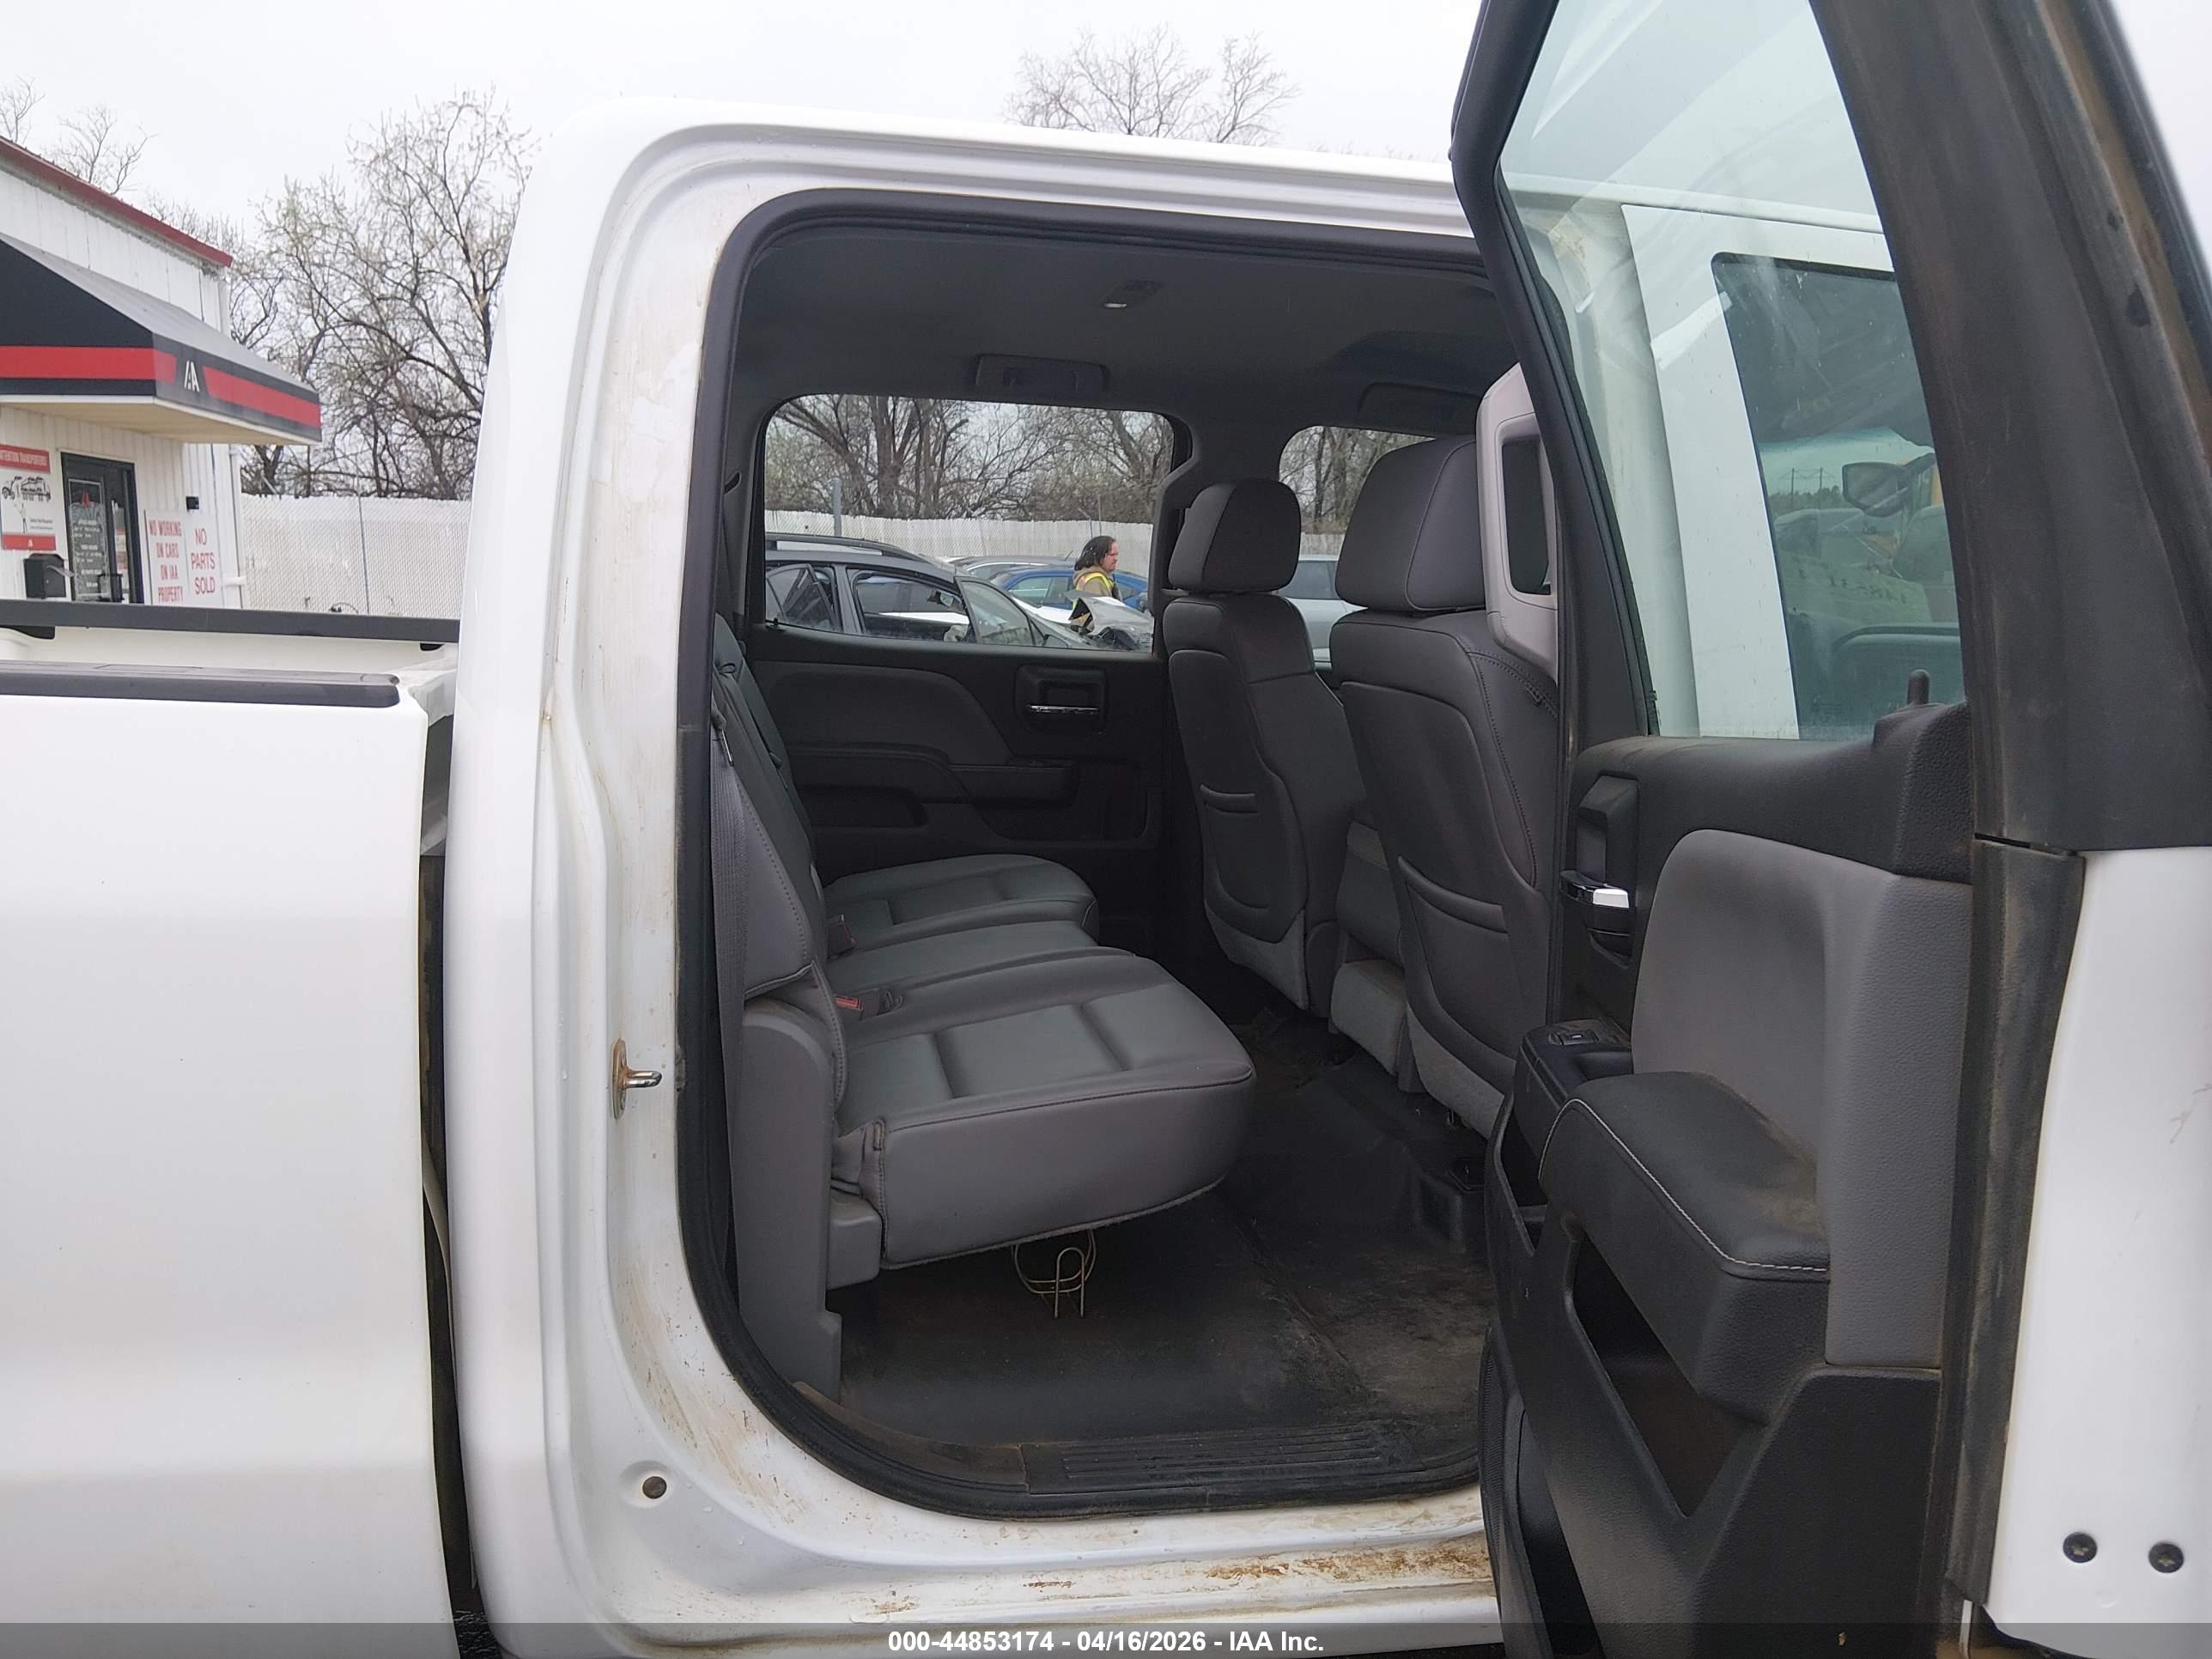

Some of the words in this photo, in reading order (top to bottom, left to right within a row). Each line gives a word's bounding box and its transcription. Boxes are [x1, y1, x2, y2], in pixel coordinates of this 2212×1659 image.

[149, 520, 157, 537] NO
[158, 521, 181, 537] WORKING
[195, 528, 207, 545] NO
[156, 543, 164, 558] ON
[166, 543, 179, 558] CARS
[191, 552, 216, 570] PARTS
[160, 564, 168, 580] ON
[194, 576, 216, 595] SOLD
[158, 586, 183, 603] PROPERTY
